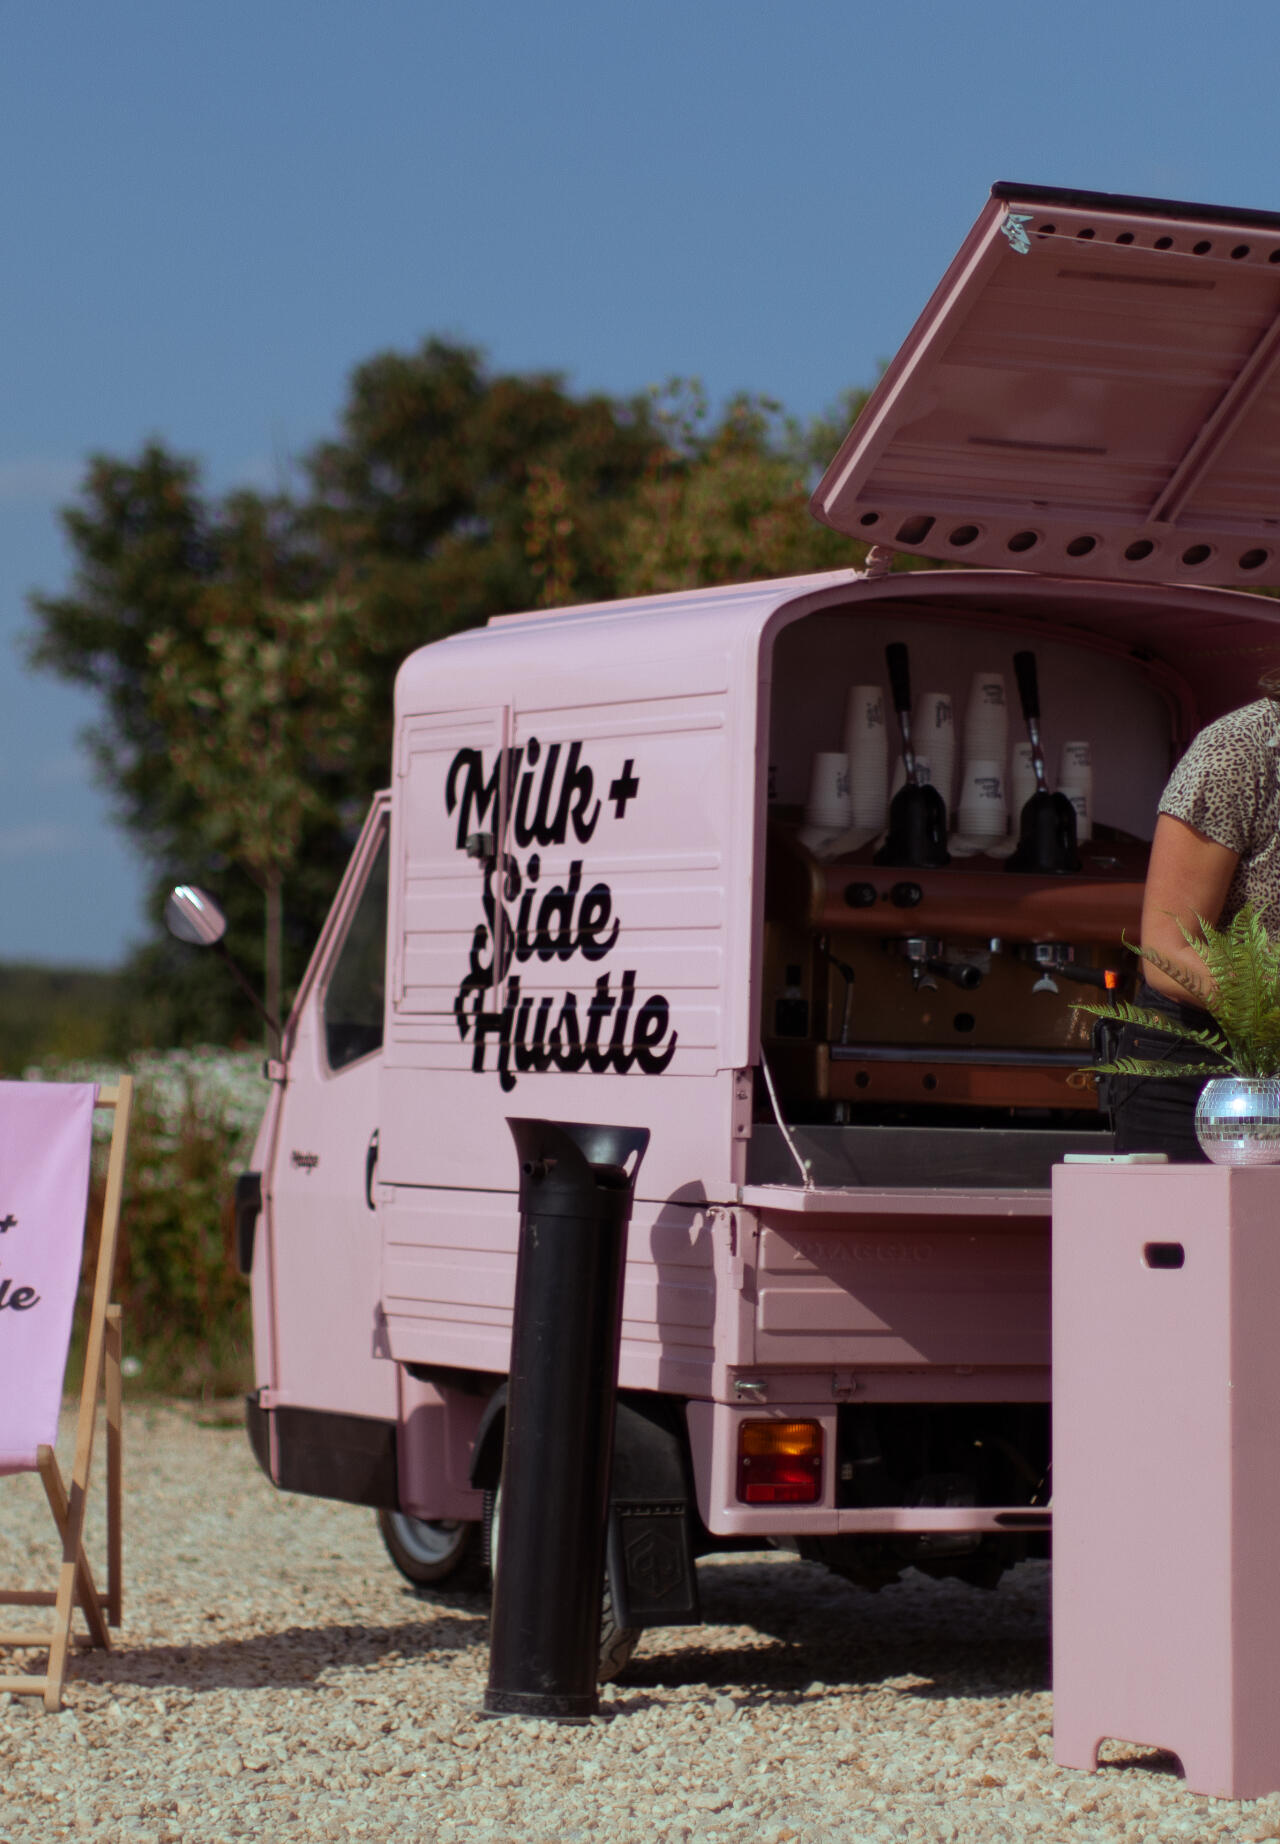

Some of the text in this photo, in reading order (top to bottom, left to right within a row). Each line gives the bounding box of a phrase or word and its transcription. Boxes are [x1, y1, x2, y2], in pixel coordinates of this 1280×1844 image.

[445, 736, 640, 851] Milk +
[470, 853, 620, 987] Side
[454, 970, 678, 1092] Hustle
